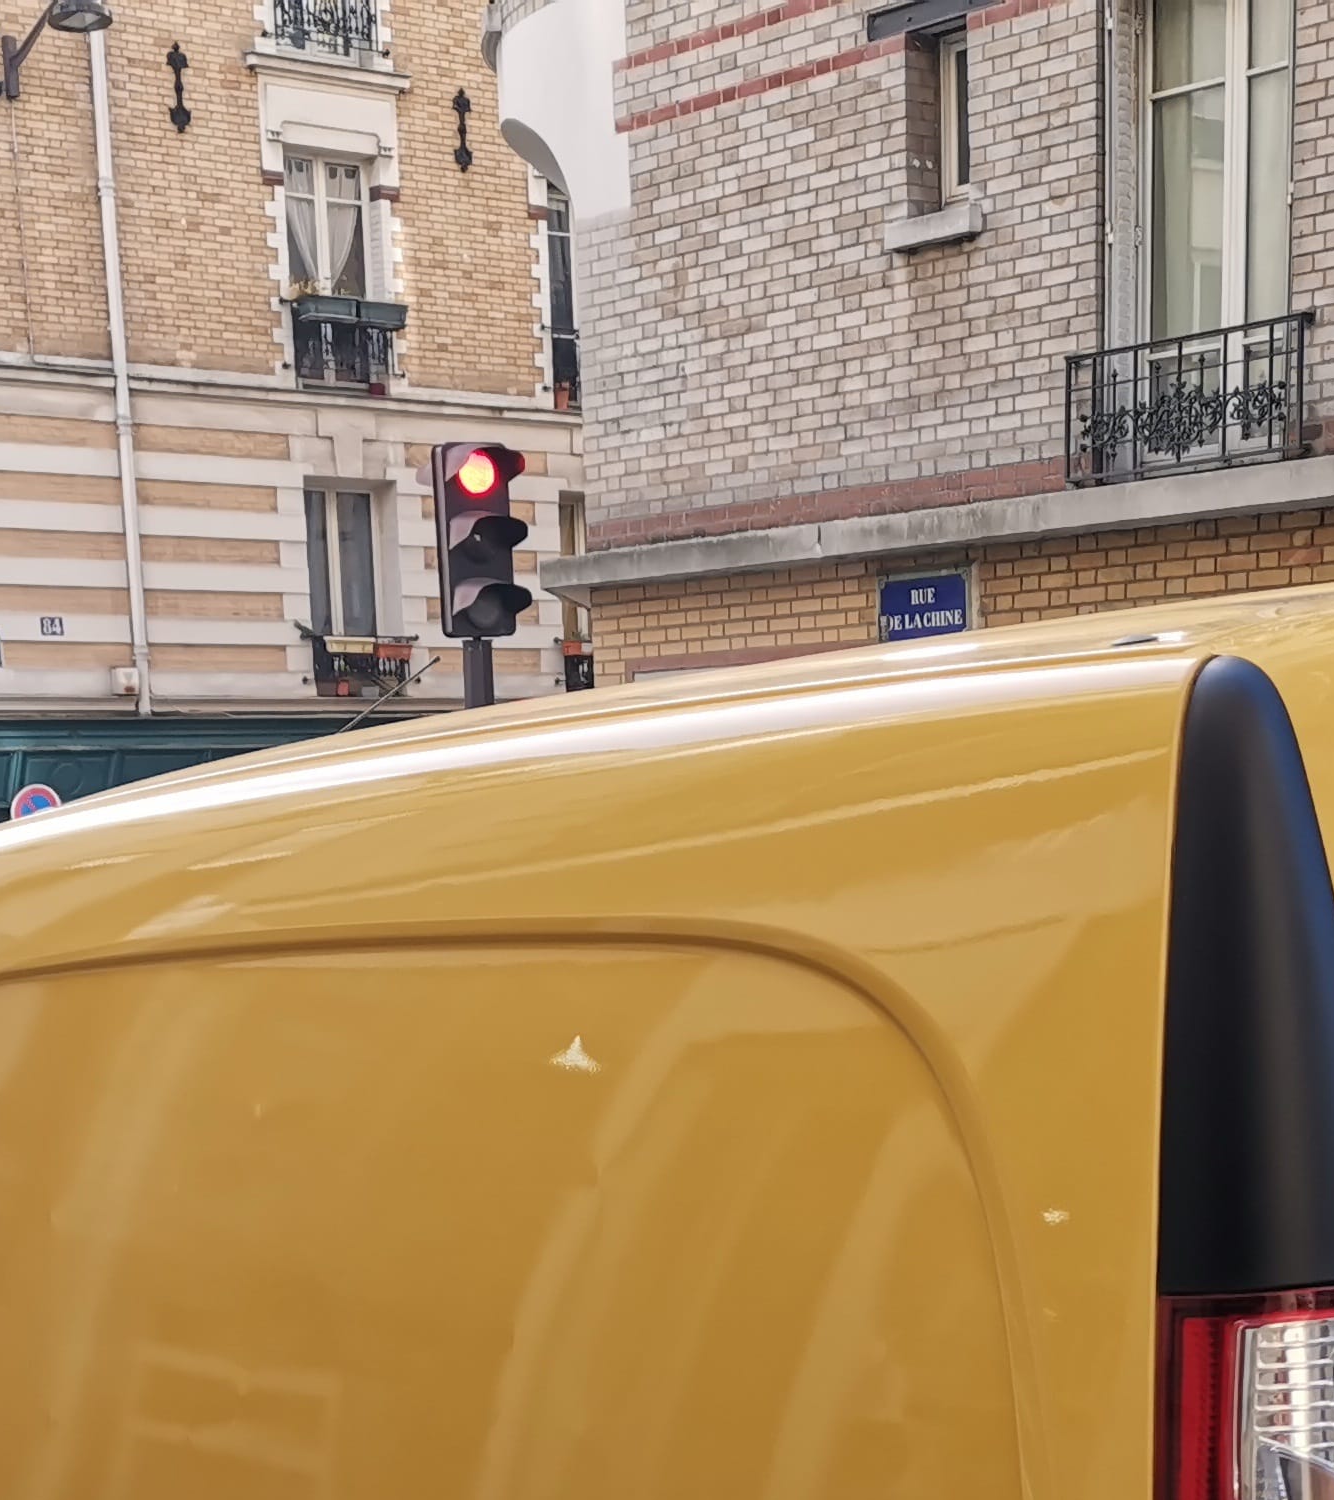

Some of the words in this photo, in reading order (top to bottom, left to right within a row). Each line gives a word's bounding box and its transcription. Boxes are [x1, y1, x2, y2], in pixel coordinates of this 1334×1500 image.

[910, 587, 936, 606] RUE
[42, 617, 63, 635] 84
[904, 612, 923, 630] LA
[923, 608, 964, 628] CHINE
